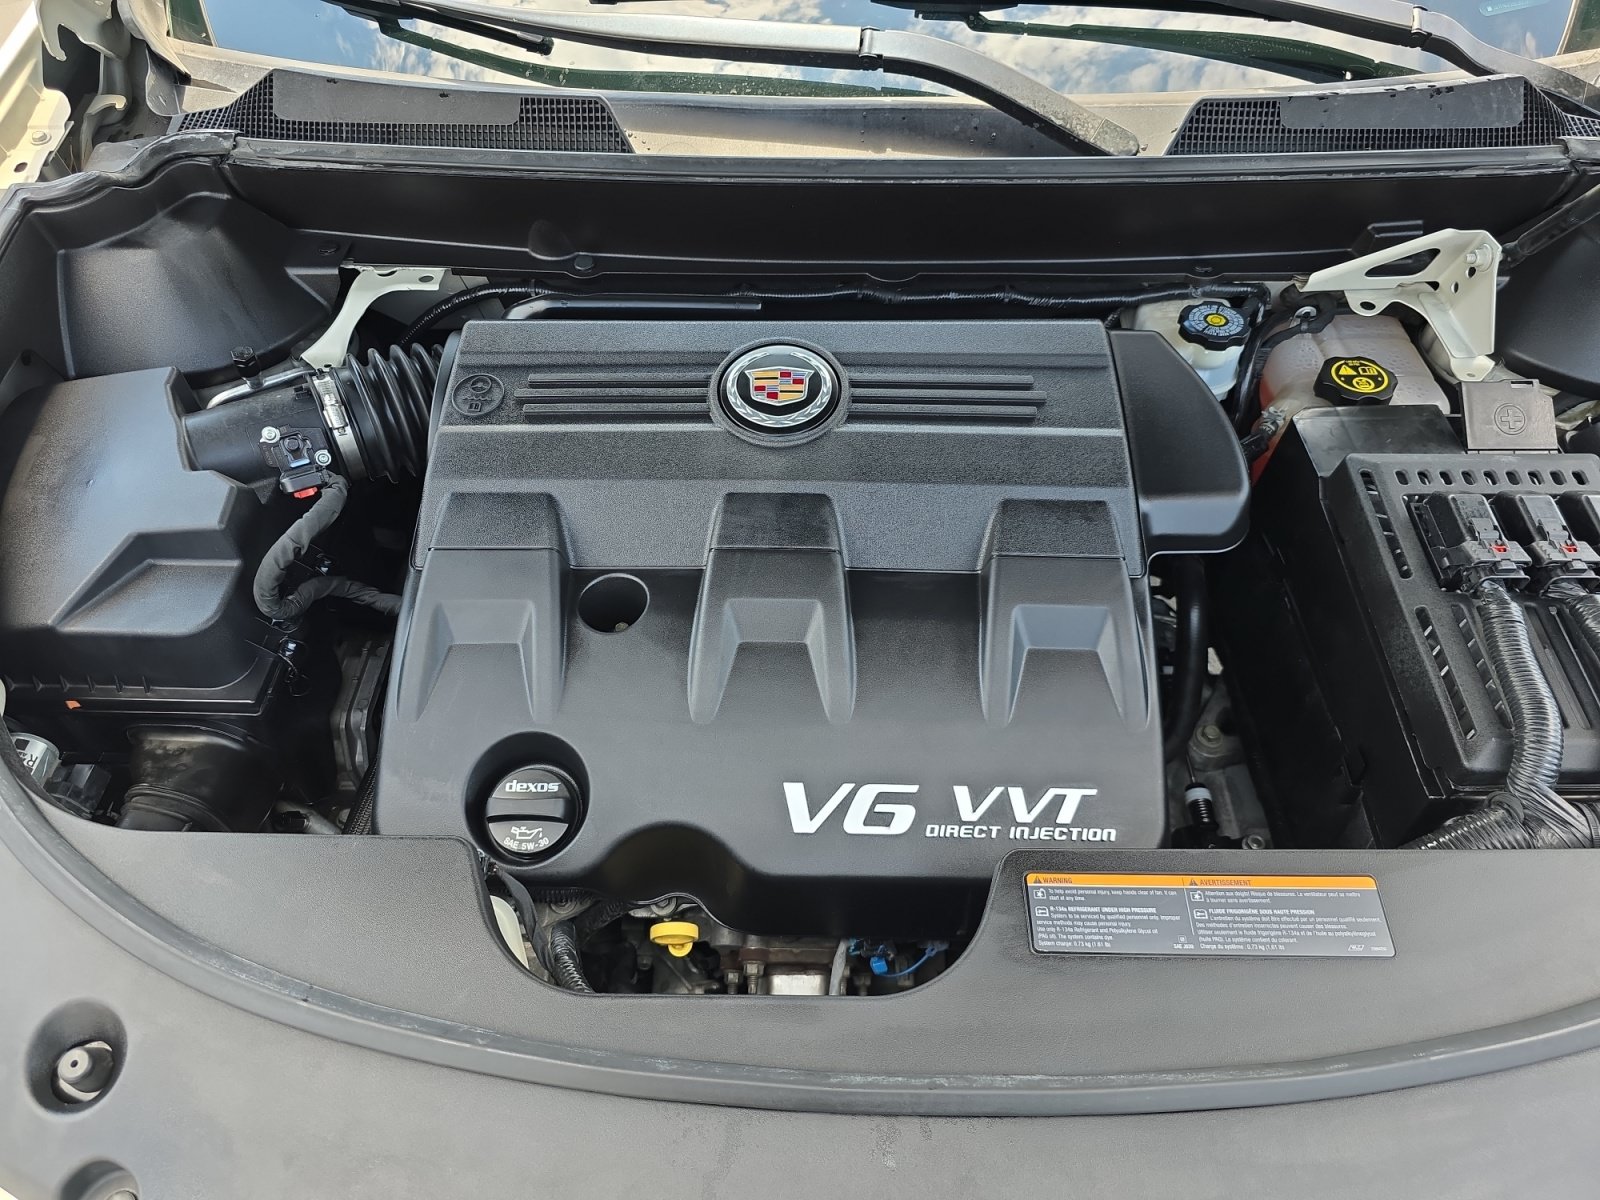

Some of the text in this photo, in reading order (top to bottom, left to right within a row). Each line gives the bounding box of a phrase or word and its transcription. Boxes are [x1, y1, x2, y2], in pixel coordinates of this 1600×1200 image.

[505, 780, 561, 792] dexos
[782, 781, 1098, 835] V6 VVT
[925, 824, 1117, 842] DIRECT INJECTION
[503, 837, 550, 850] SAE 5W-30
